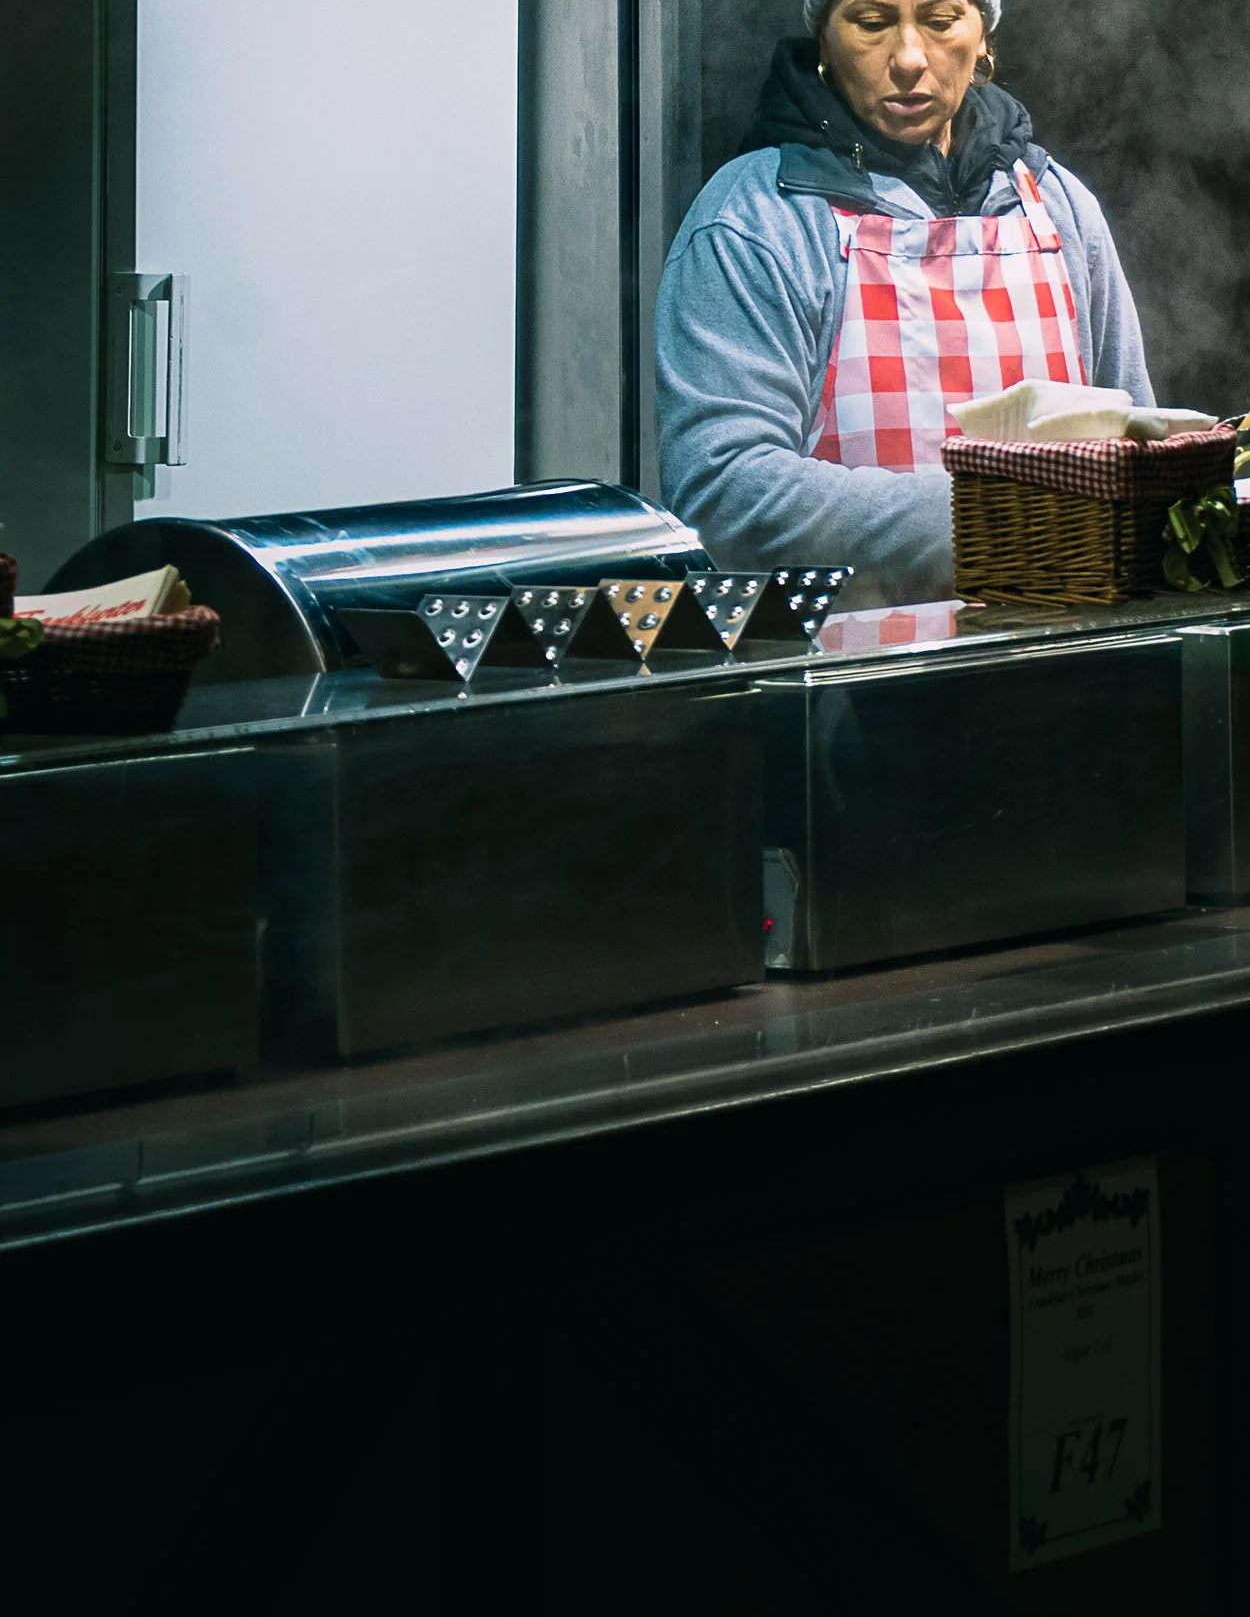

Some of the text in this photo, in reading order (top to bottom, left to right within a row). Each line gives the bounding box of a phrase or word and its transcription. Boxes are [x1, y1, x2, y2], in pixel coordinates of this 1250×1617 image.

[1029, 1246, 1144, 1289] Merry Christmas
[1049, 1416, 1130, 1495] F47
